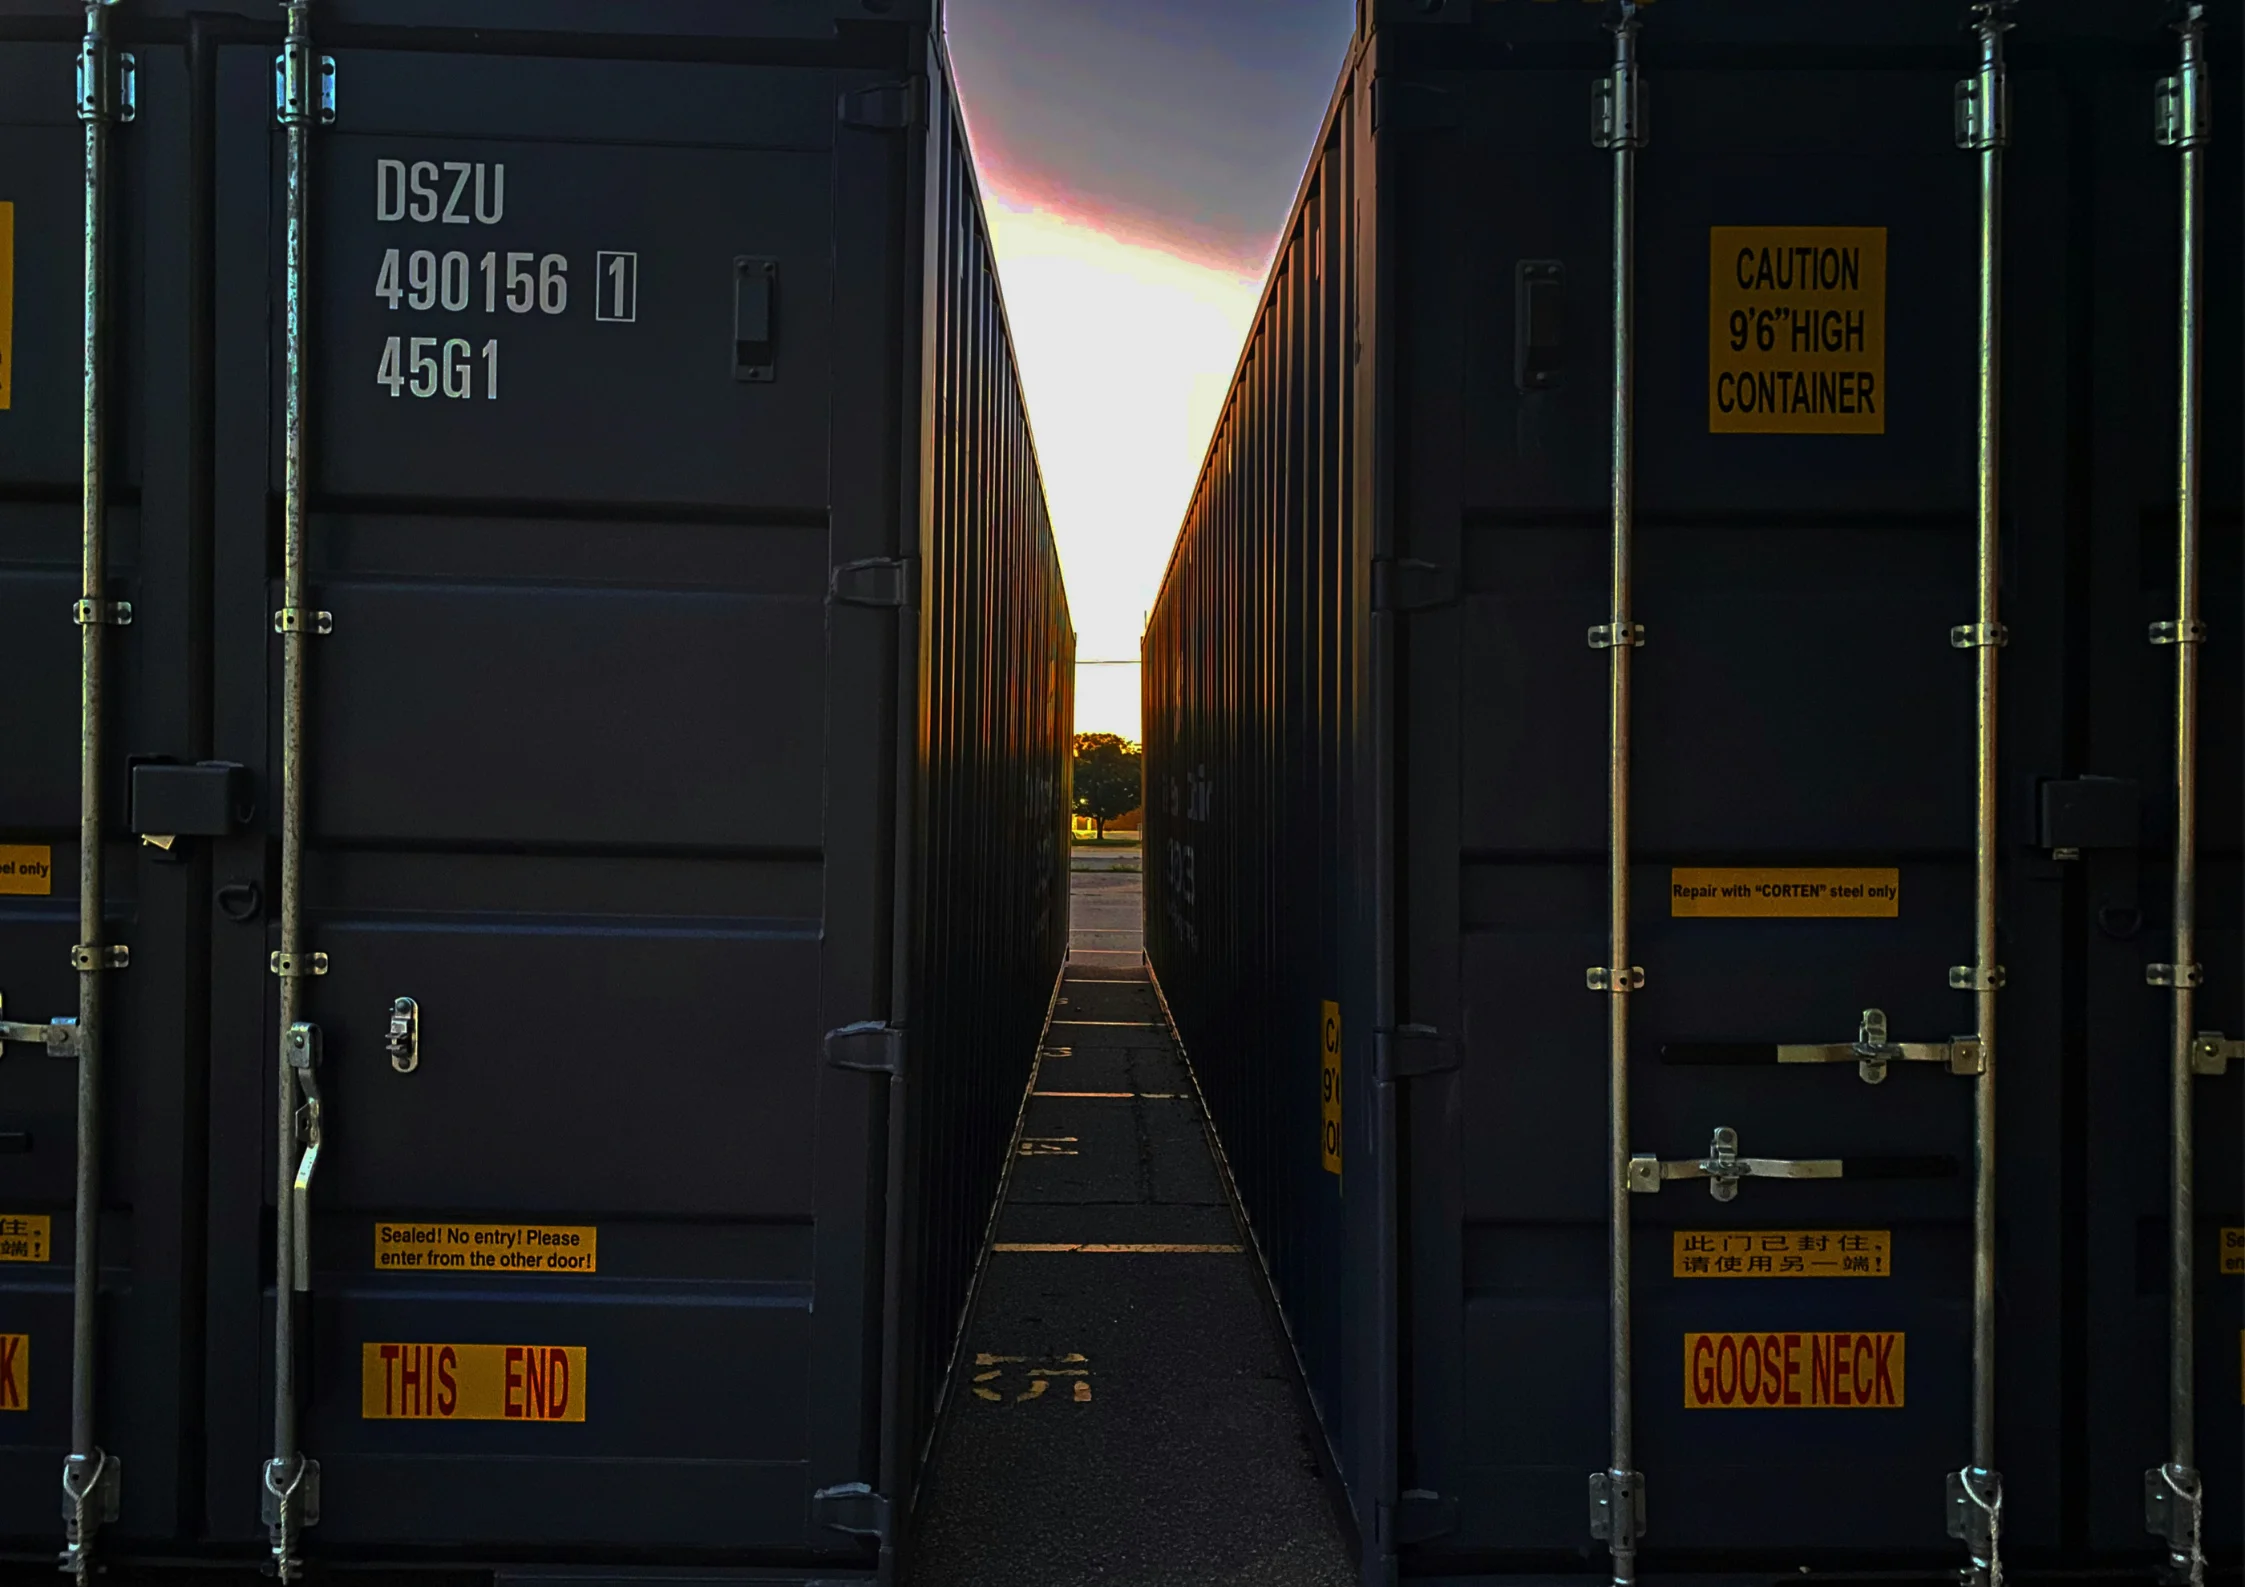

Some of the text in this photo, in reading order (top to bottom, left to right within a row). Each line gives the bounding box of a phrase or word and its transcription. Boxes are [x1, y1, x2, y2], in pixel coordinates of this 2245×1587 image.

[377, 159, 504, 224] DSZU
[375, 249, 568, 315] 490156
[1737, 247, 1859, 290] CAUTION
[377, 336, 498, 400] 45G1
[1718, 372, 1875, 413] CONTAINER
[20, 861, 49, 878] only
[1673, 884, 1897, 900] Repair with "CORTEN" steel only
[381, 1226, 580, 1248] Sealed! No entry! Please
[381, 1250, 592, 1269] enter from the other door!
[380, 1345, 569, 1419] THIS END
[1693, 1334, 1895, 1405] GOOSE NECK
